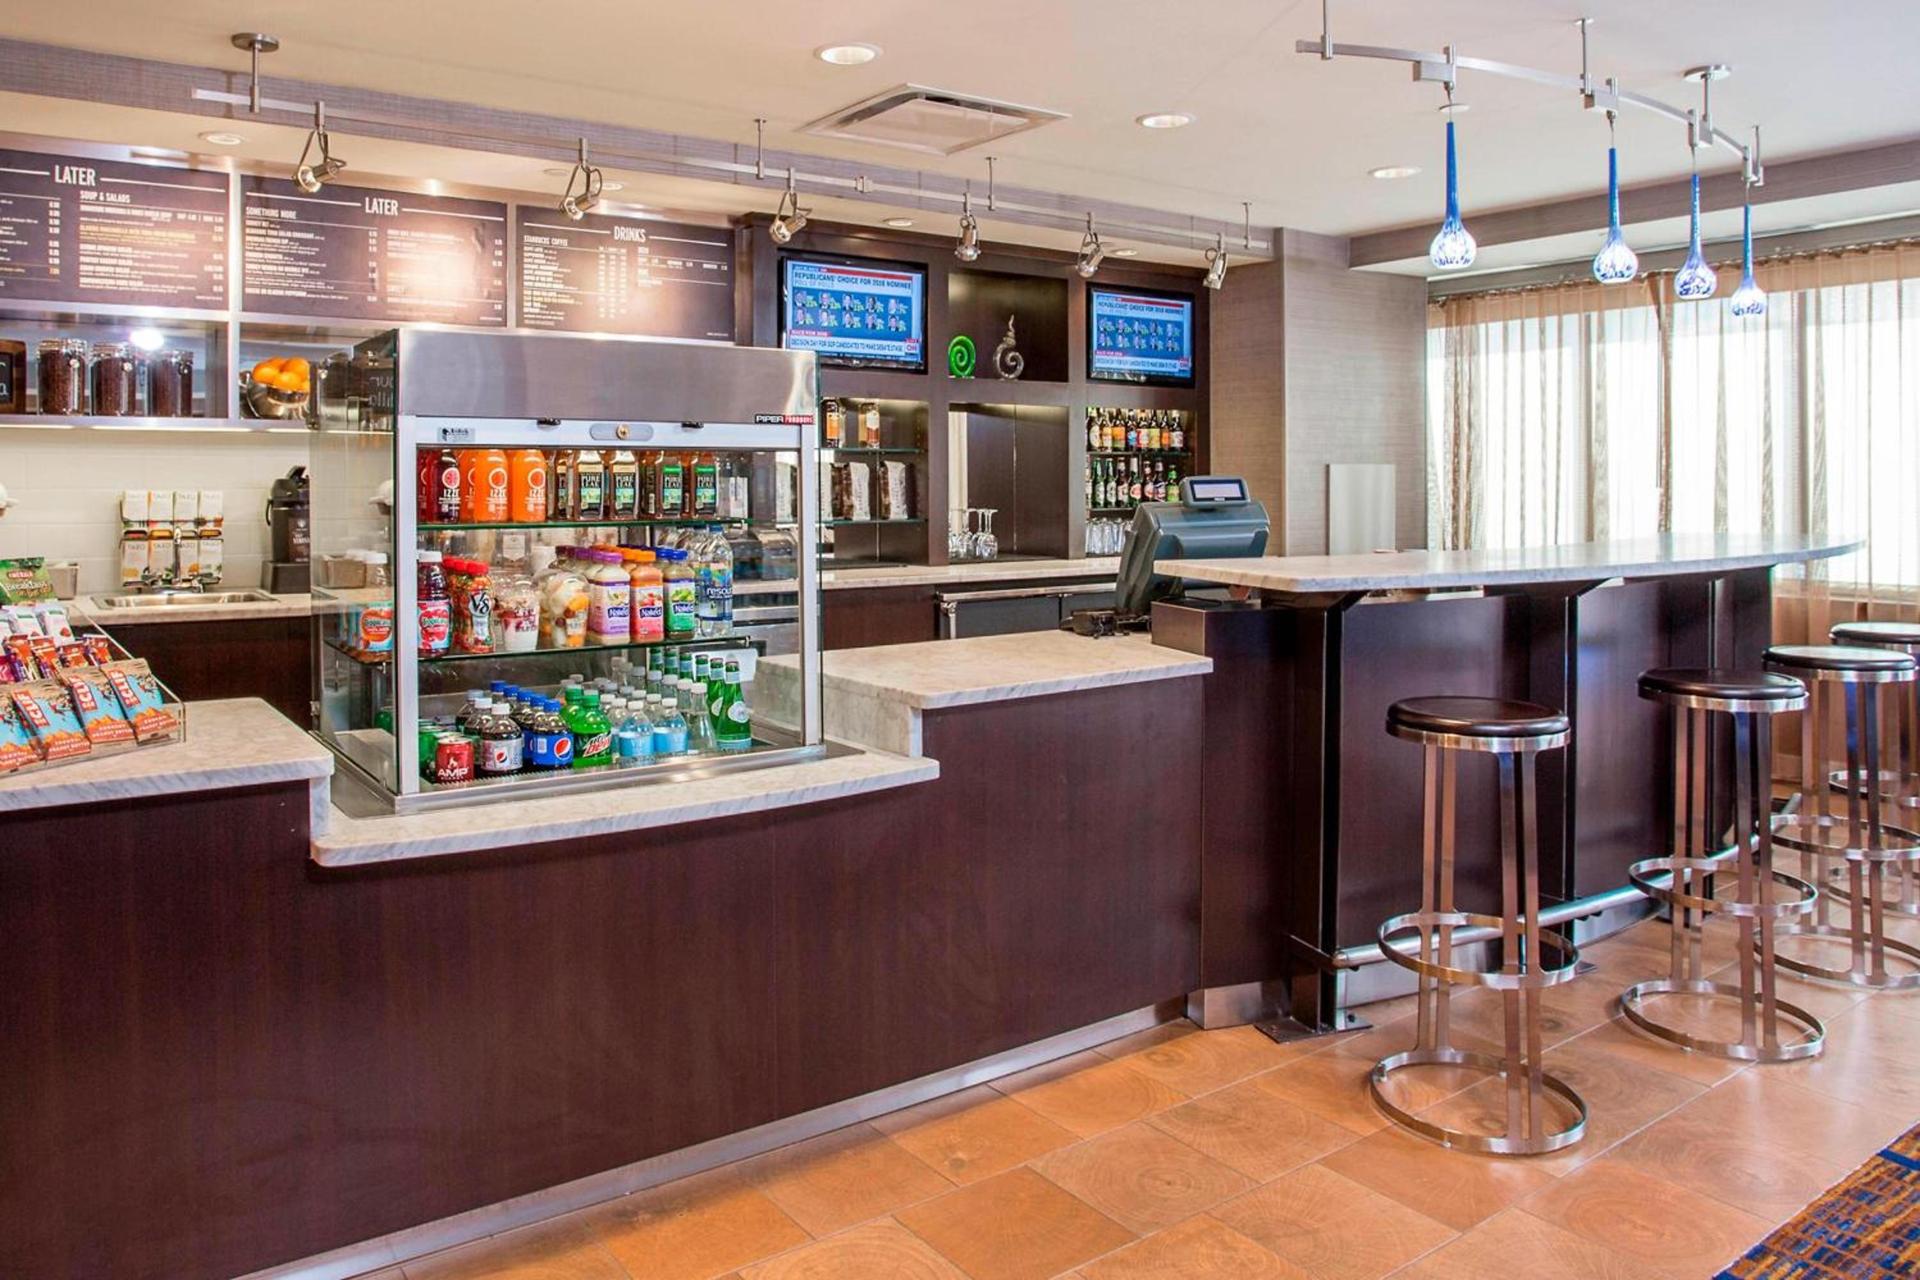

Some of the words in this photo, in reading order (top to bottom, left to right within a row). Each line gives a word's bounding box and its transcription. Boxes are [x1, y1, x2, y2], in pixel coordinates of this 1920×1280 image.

[55, 165, 96, 186] LATER
[365, 197, 399, 216] LATER
[614, 226, 647, 242] DRINKS
[755, 415, 783, 424] PIPER
[470, 592, 489, 614] V8
[438, 767, 469, 777] AMP
